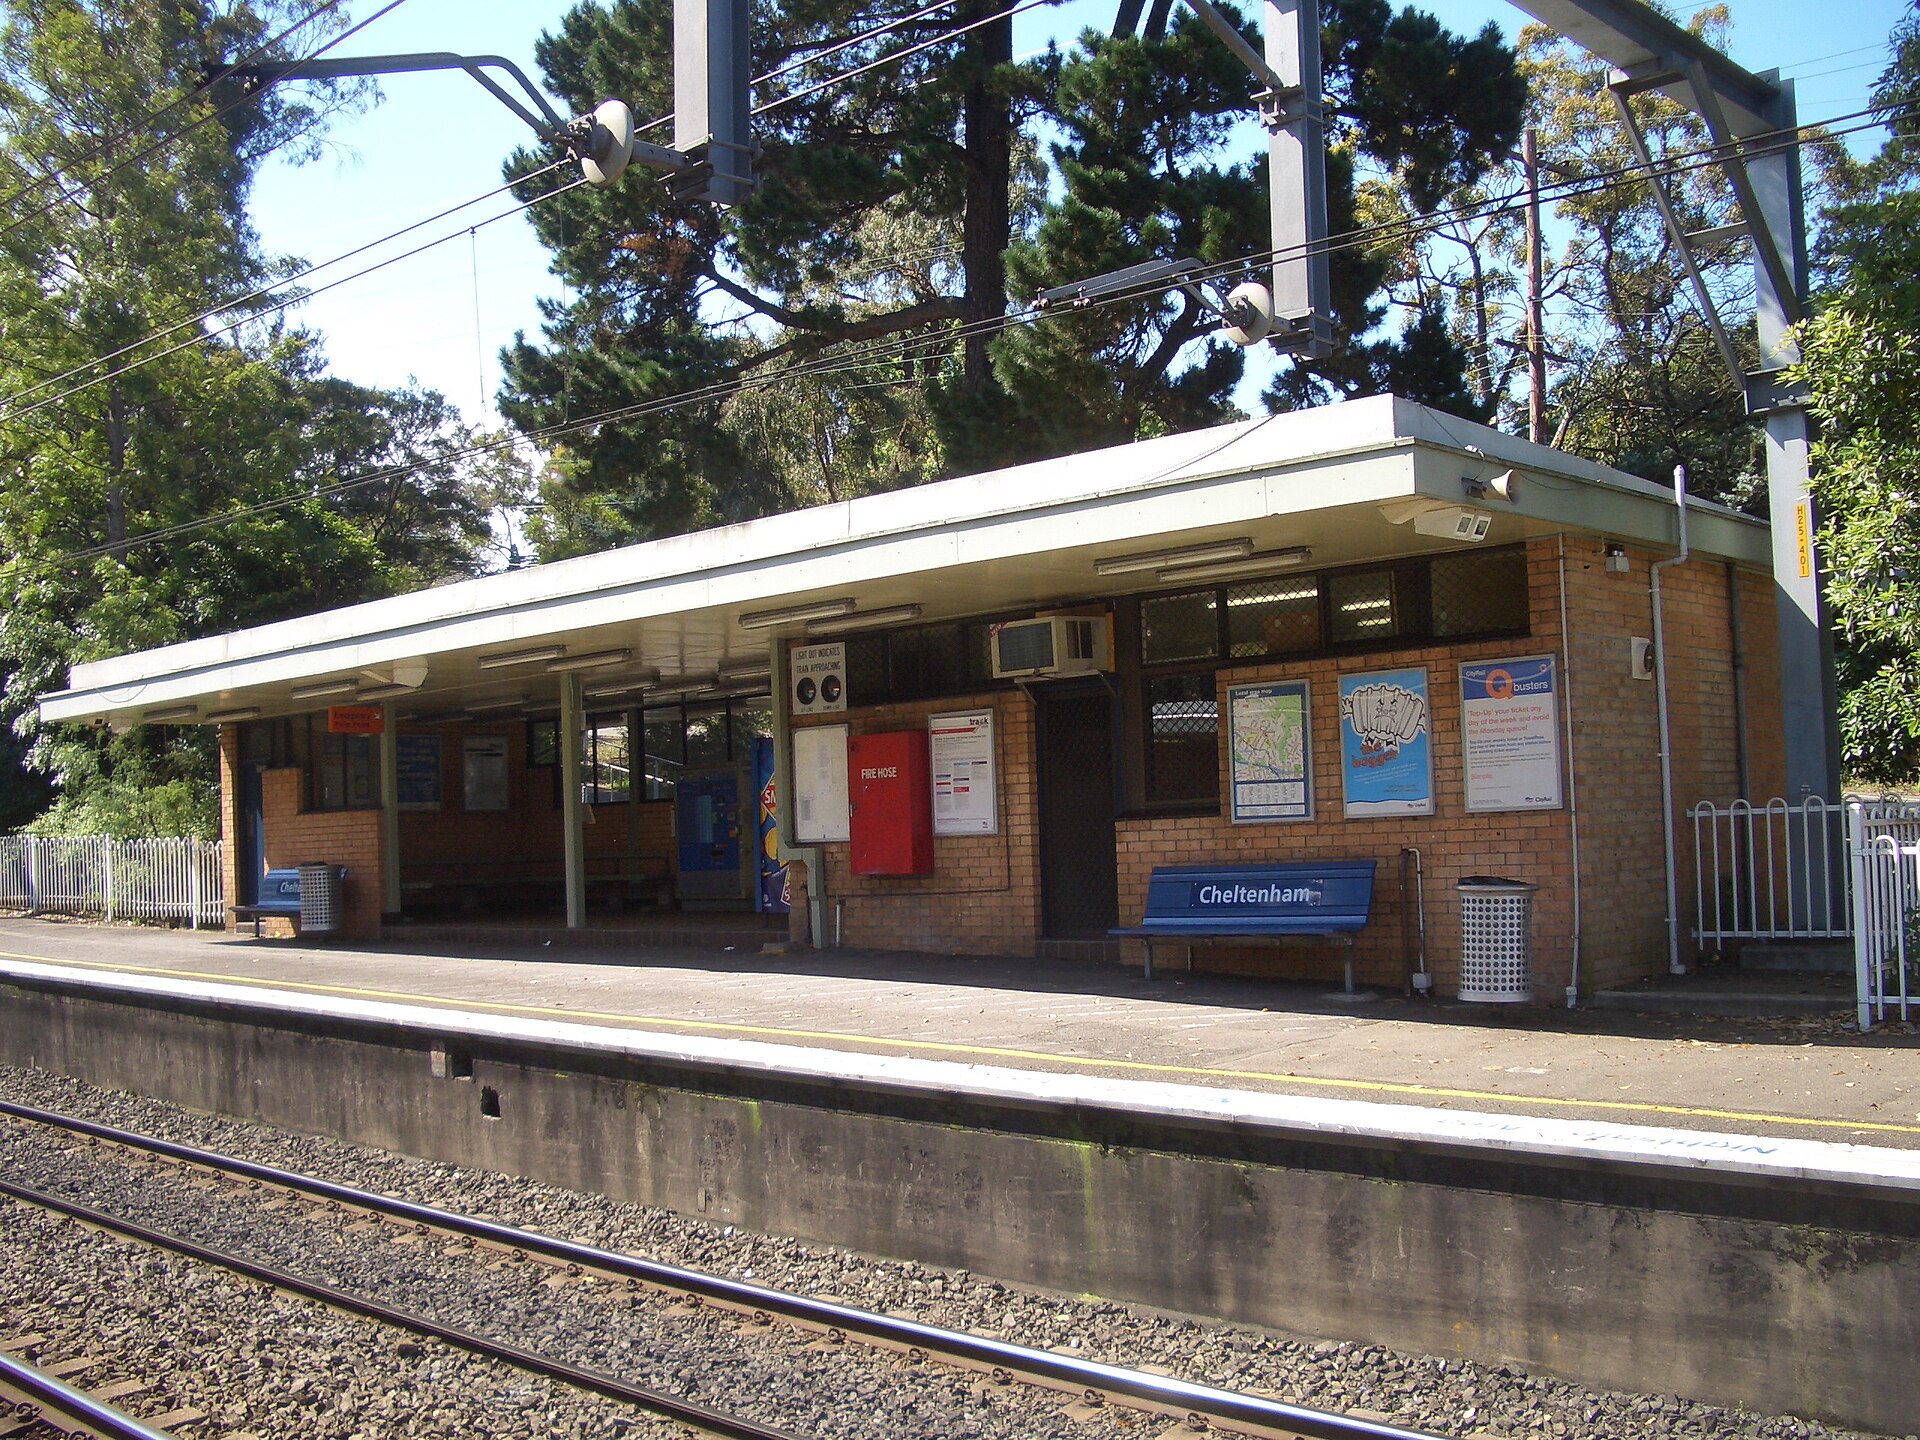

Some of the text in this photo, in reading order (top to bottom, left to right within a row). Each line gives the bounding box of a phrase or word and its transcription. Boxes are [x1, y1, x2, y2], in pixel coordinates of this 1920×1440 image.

[796, 647, 840, 660] LIGHT OUT INDICATES
[797, 661, 840, 673] TRAIN APPROACHING
[1485, 669, 1548, 699] Q busters
[861, 766, 897, 780] FIRE HOSE
[1200, 883, 1310, 904] Cheltenham
